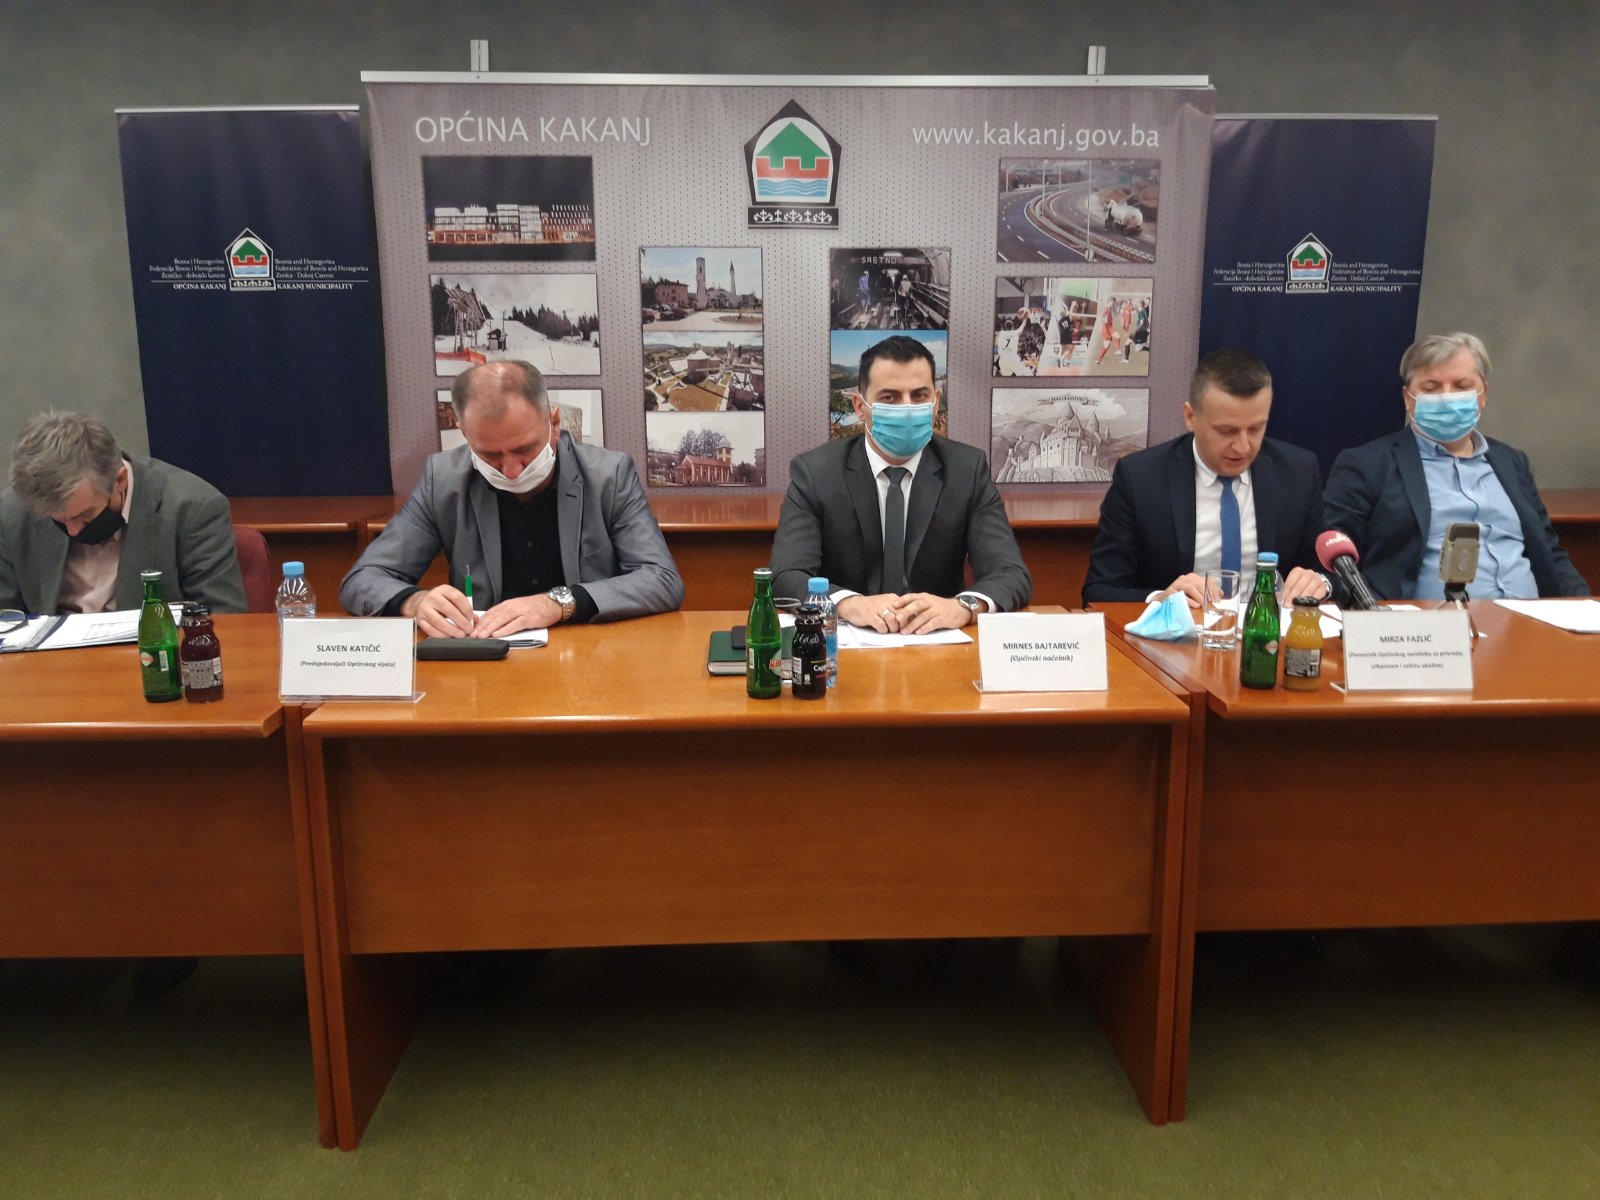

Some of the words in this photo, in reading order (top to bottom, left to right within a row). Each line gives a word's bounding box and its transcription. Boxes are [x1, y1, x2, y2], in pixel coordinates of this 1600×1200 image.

[415, 110, 529, 142] OPĆINA
[540, 117, 650, 146] KAKANJ
[912, 122, 1160, 151] www.kakanj.gov.ba
[1005, 338, 1011, 348] 7
[350, 643, 380, 652] KATIČIĆ
[1035, 641, 1080, 650] BAJTAREVIĆ
